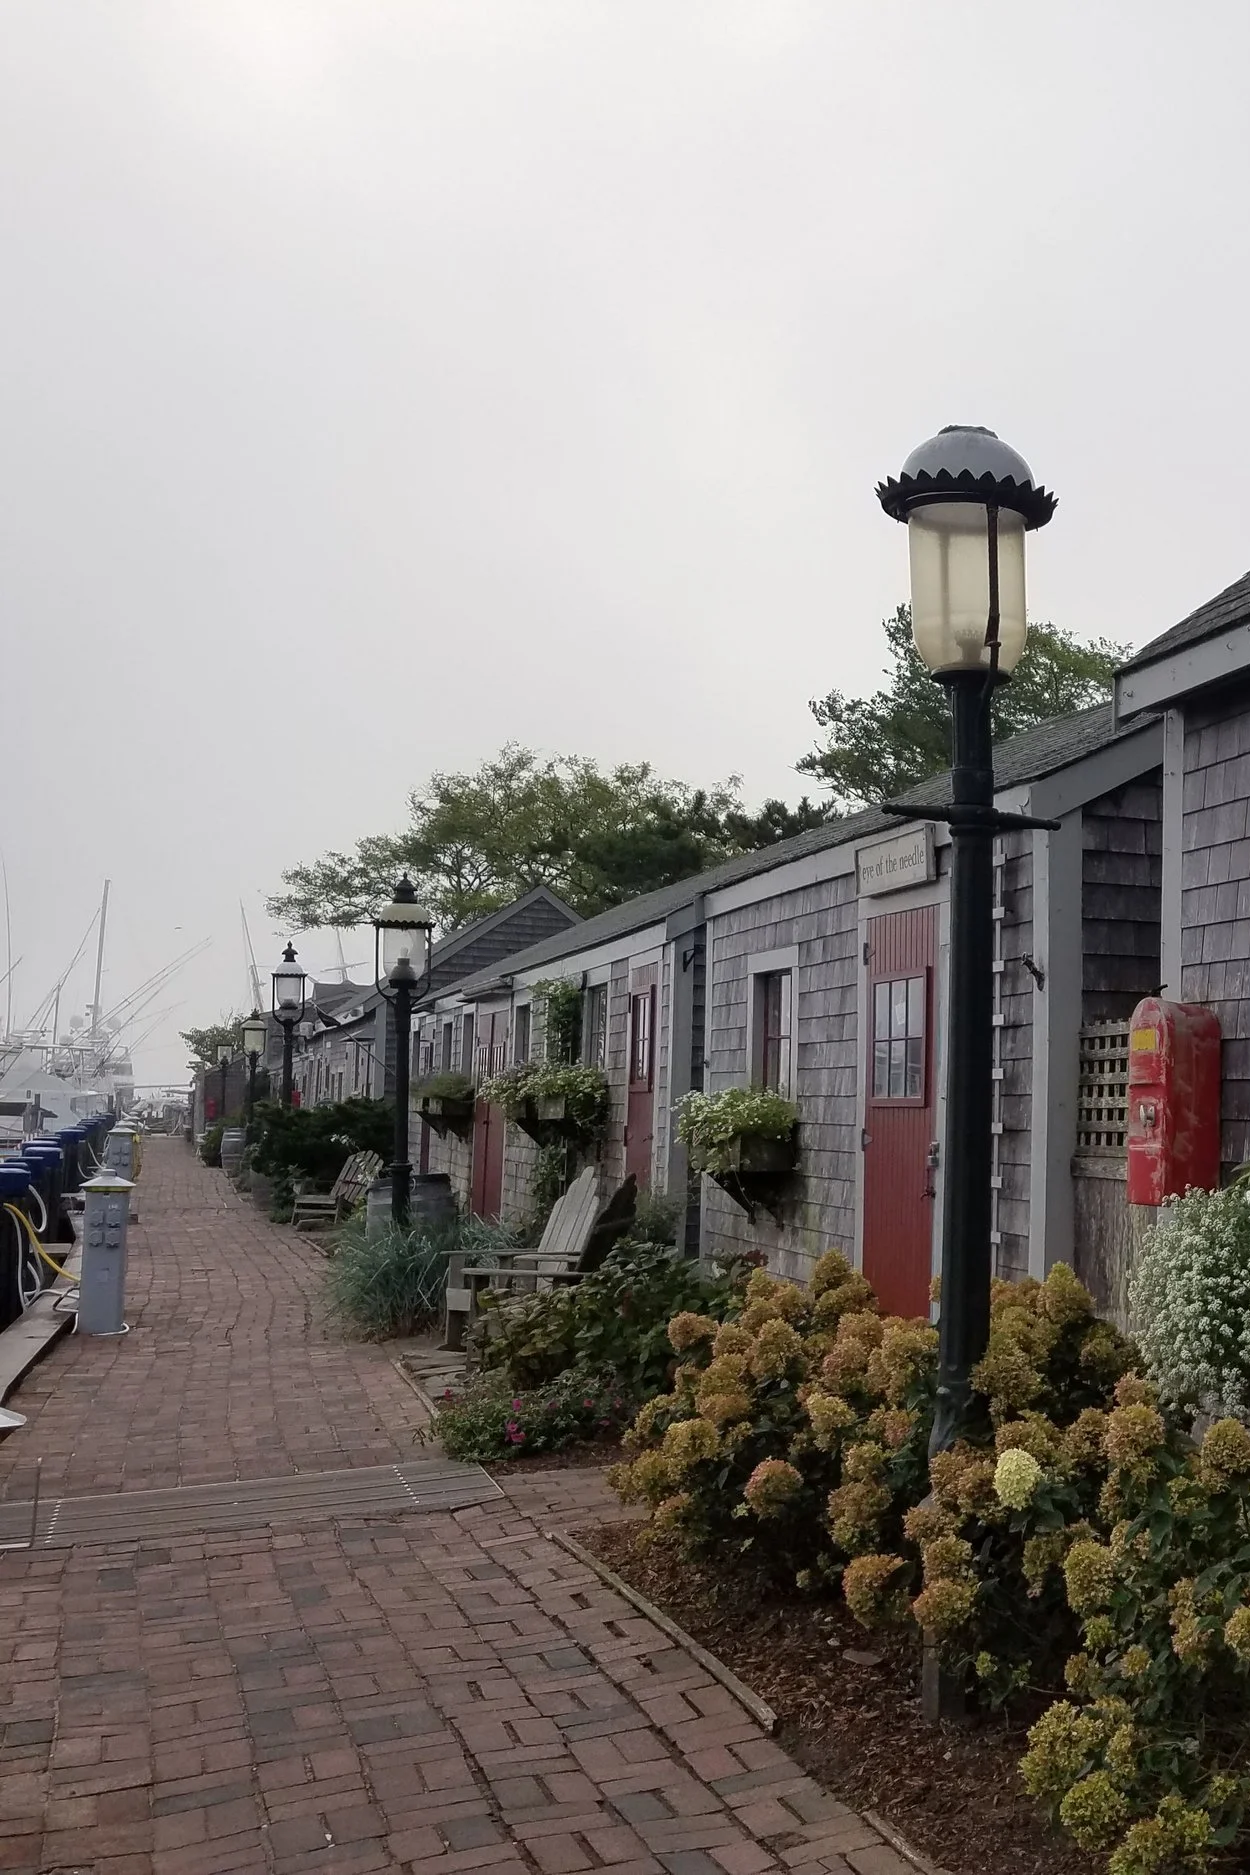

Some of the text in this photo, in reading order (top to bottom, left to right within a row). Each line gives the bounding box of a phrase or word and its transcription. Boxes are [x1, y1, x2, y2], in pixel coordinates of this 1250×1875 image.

[862, 845, 925, 883] eye of the needle
